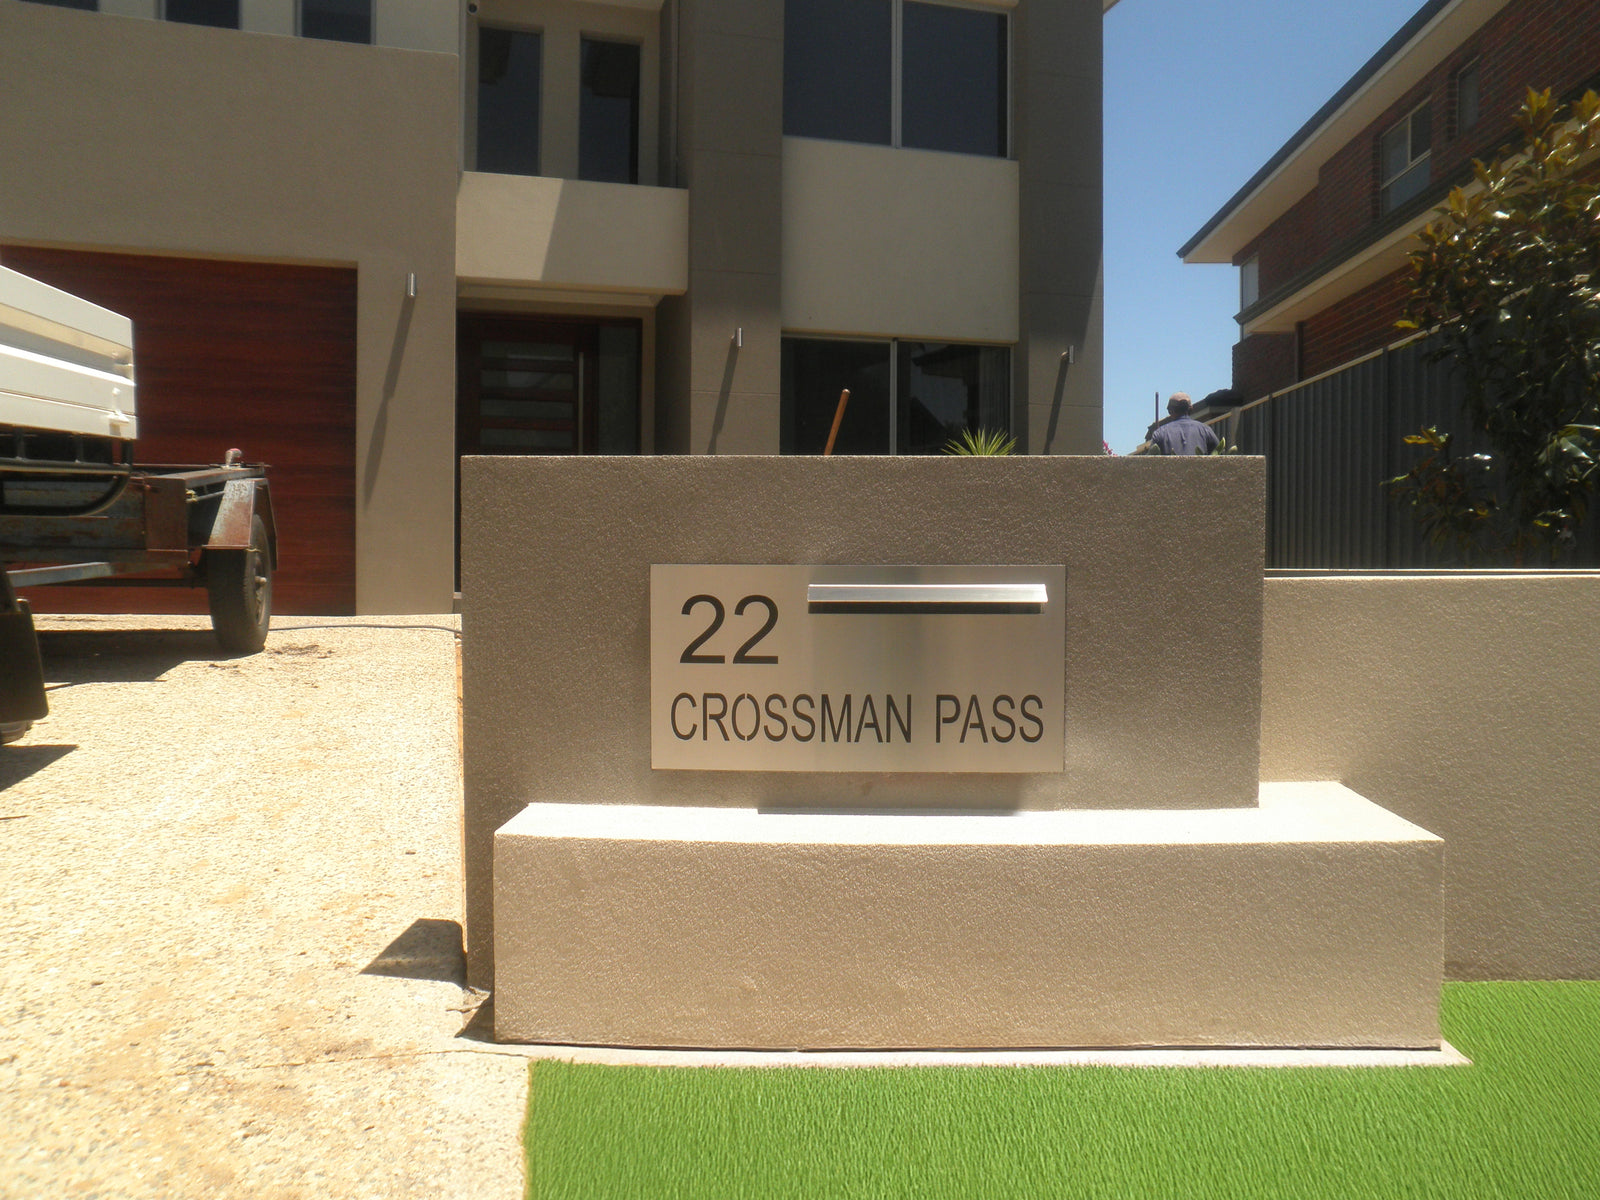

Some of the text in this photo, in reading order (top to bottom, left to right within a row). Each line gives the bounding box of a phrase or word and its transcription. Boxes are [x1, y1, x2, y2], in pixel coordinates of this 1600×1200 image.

[679, 593, 779, 665] 22
[670, 692, 1045, 744] CROSSMAN PASS
